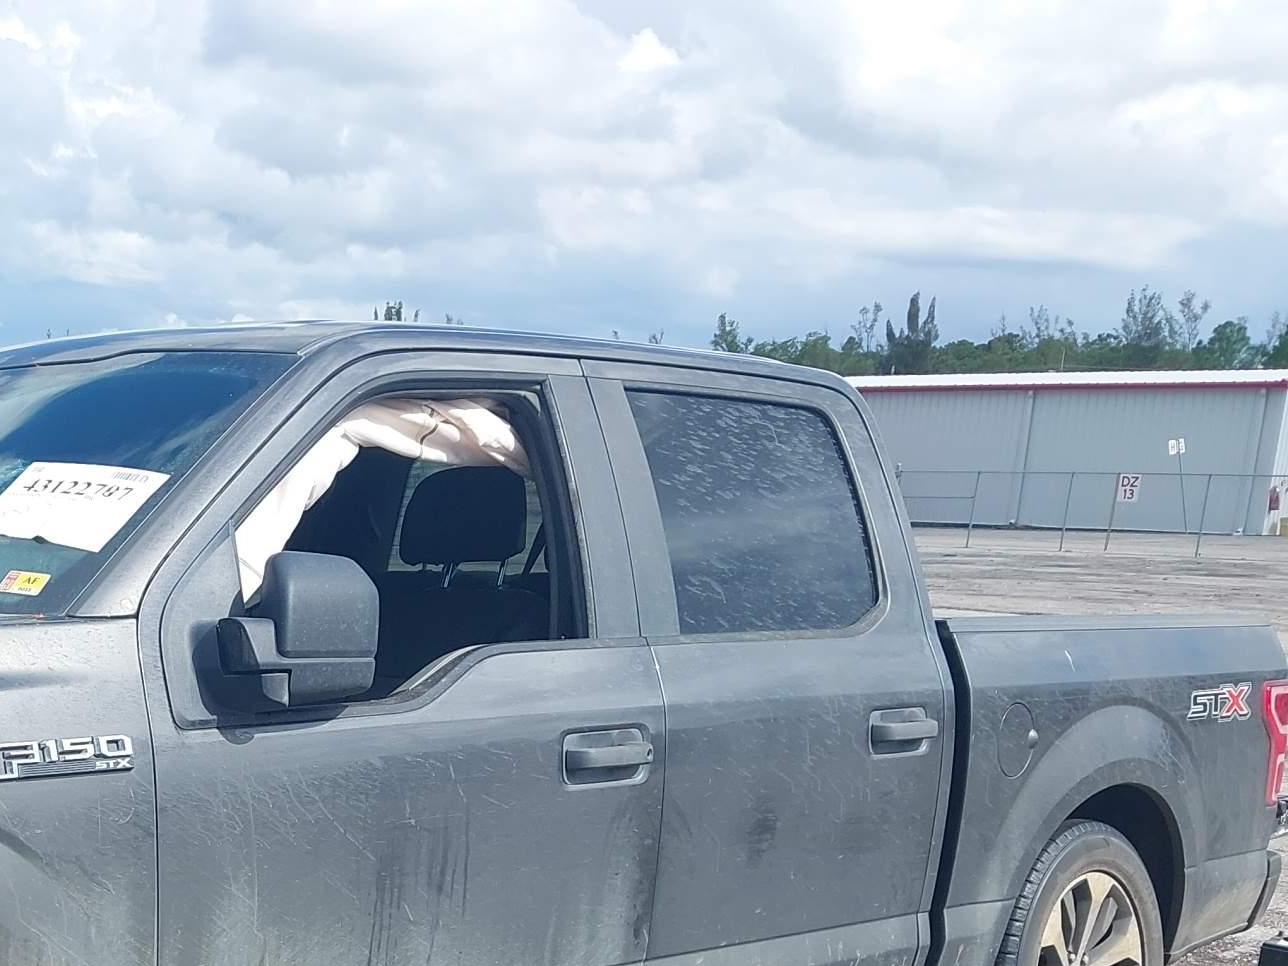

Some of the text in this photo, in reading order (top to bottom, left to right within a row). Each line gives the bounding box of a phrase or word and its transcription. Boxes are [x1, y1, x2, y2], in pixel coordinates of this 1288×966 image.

[1121, 475, 1140, 488] DZ
[1123, 488, 1135, 500] 13
[1187, 682, 1251, 721] STX
[95, 758, 132, 770] STX
